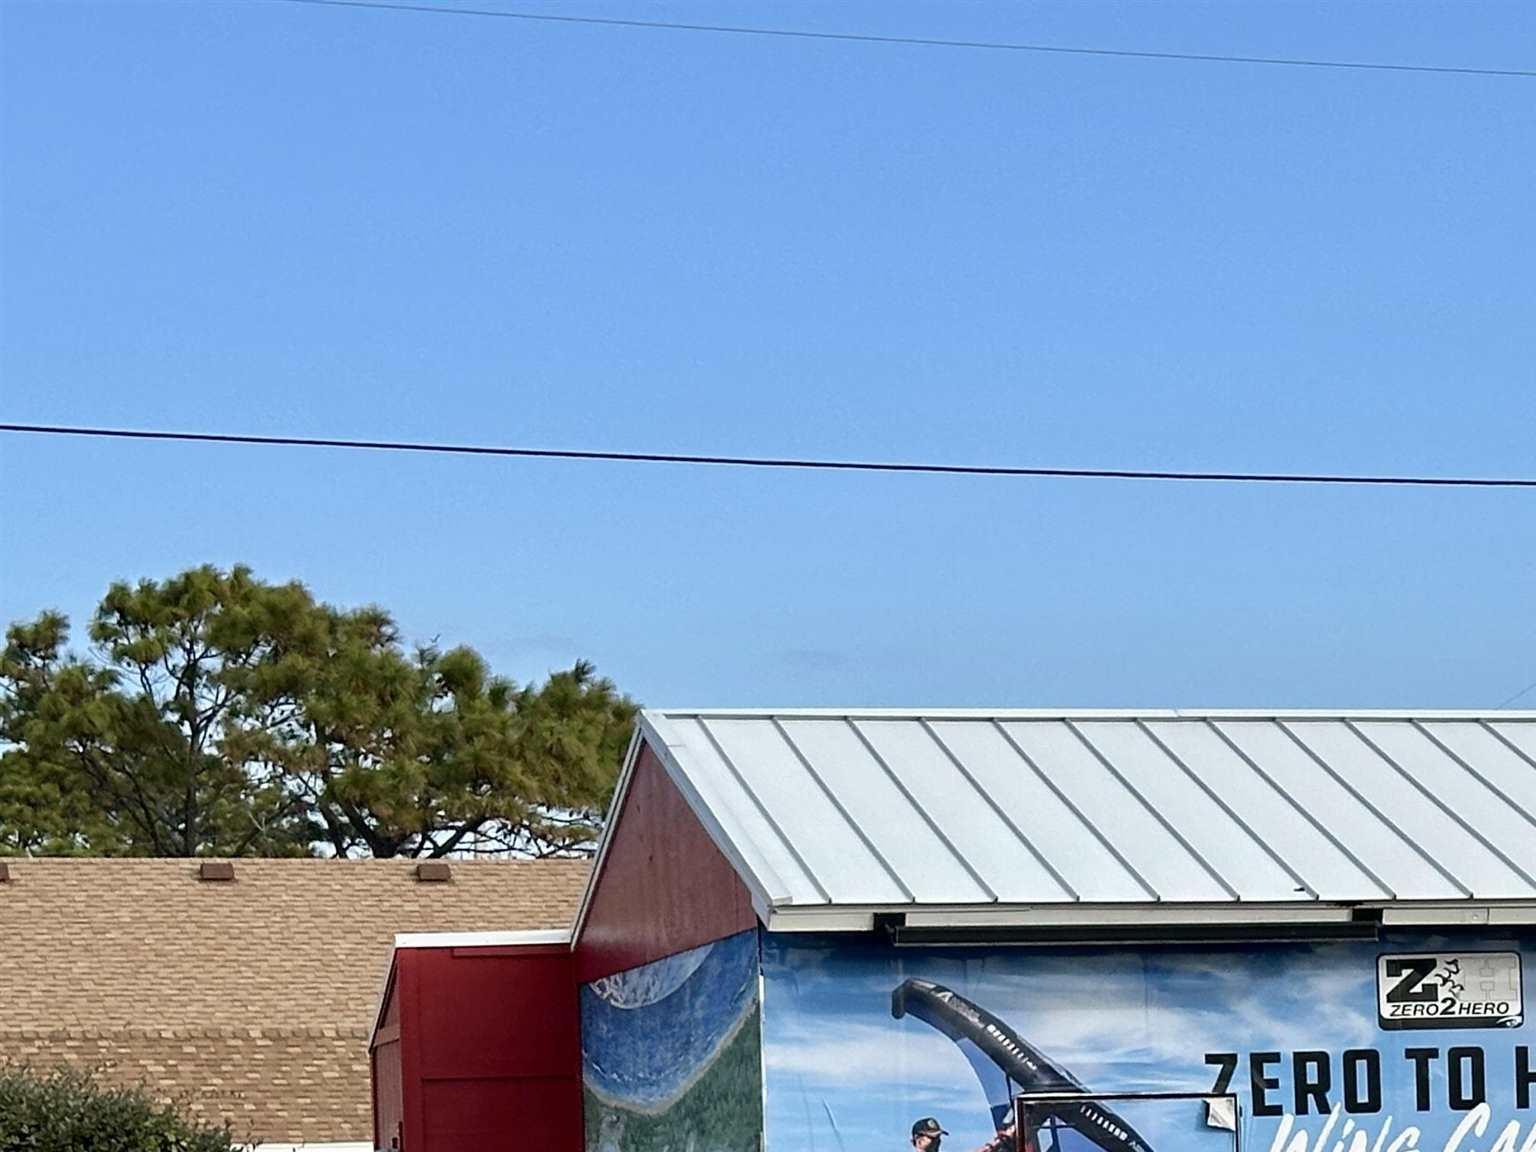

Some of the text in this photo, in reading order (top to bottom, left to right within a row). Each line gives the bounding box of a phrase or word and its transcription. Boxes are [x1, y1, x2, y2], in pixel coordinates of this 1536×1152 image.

[1390, 997, 1510, 1017] ZERO2HERO
[1205, 1048, 1382, 1116] ZERO
[1406, 1047, 1488, 1111] TO
